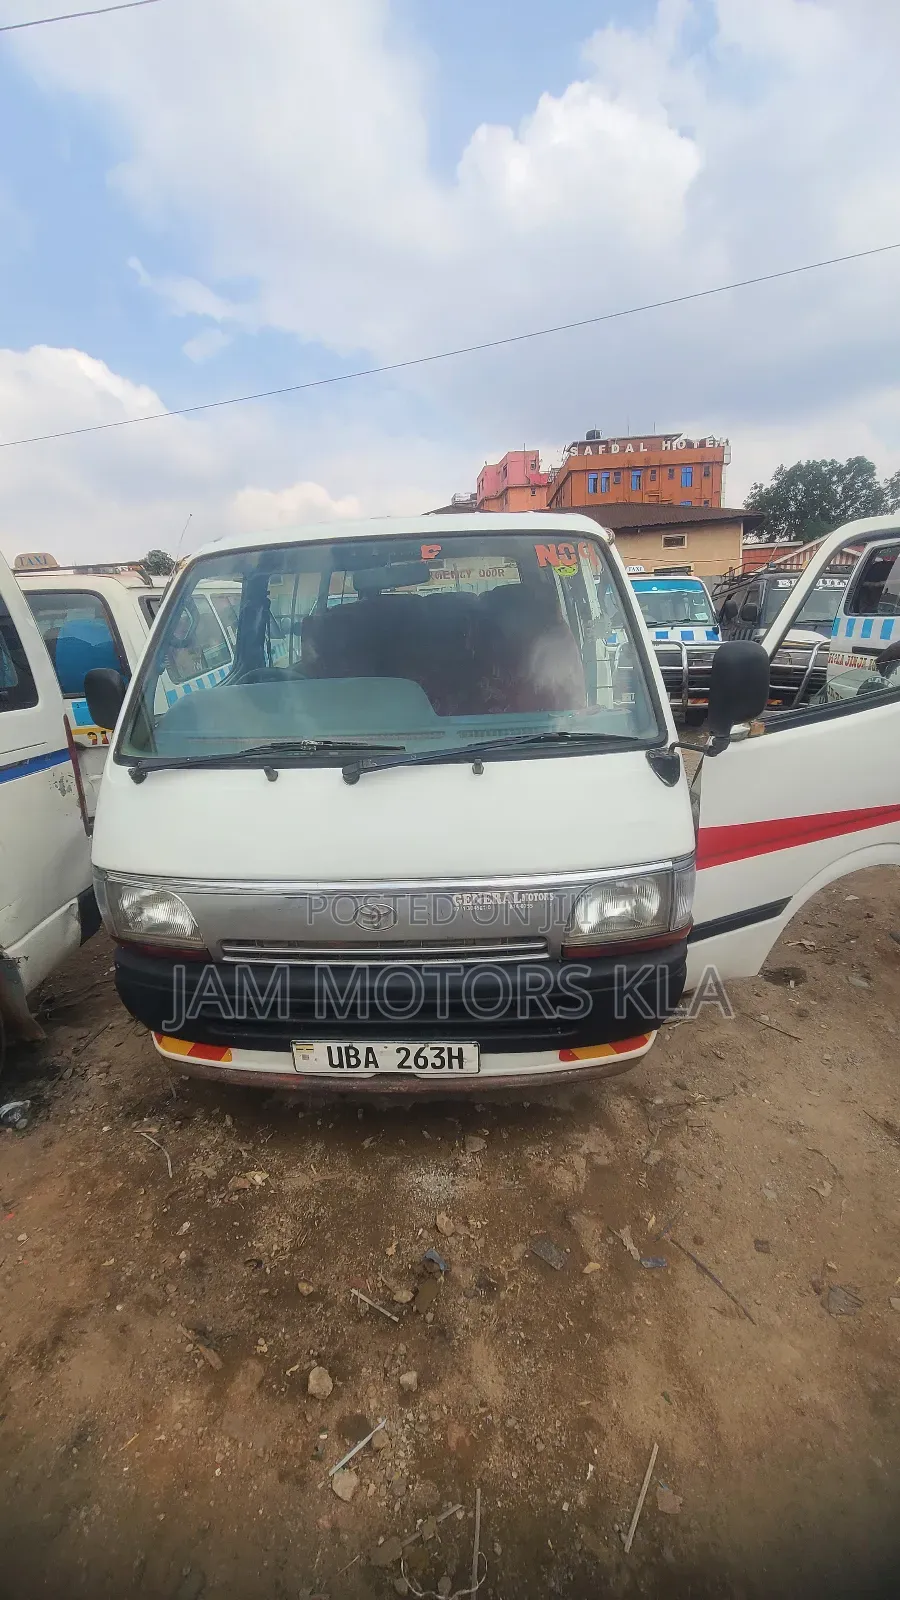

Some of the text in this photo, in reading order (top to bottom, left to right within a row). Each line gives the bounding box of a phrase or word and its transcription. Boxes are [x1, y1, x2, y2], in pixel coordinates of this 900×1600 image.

[570, 437, 729, 456] SAFDAL HOTEL
[19, 555, 48, 567] TAXI
[452, 892, 522, 906] GENERAL
[522, 892, 555, 902] MOTORS
[326, 1045, 464, 1070] UBA 263H
